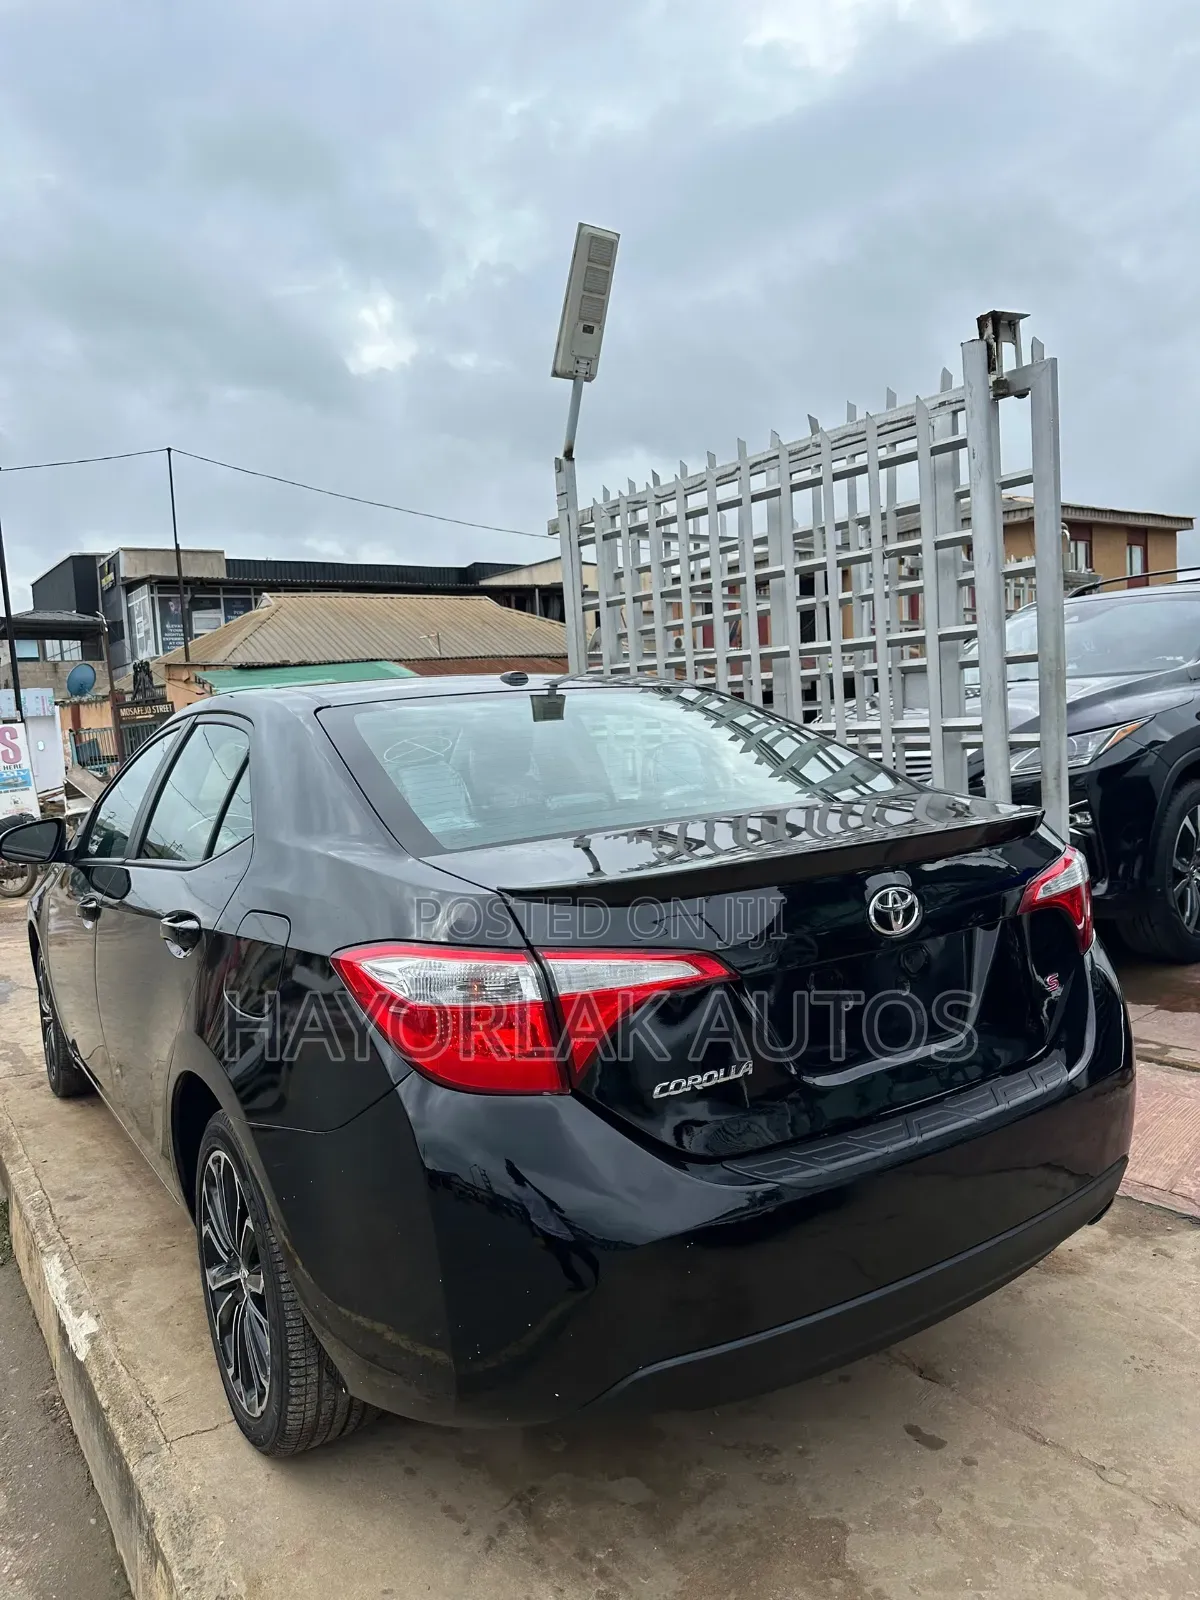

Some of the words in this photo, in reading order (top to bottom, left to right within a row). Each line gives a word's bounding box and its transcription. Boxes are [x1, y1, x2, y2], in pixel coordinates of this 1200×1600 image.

[120, 705, 152, 717] MOSAFEJO
[151, 703, 173, 714] STREET
[652, 1060, 754, 1099] COROLLA
